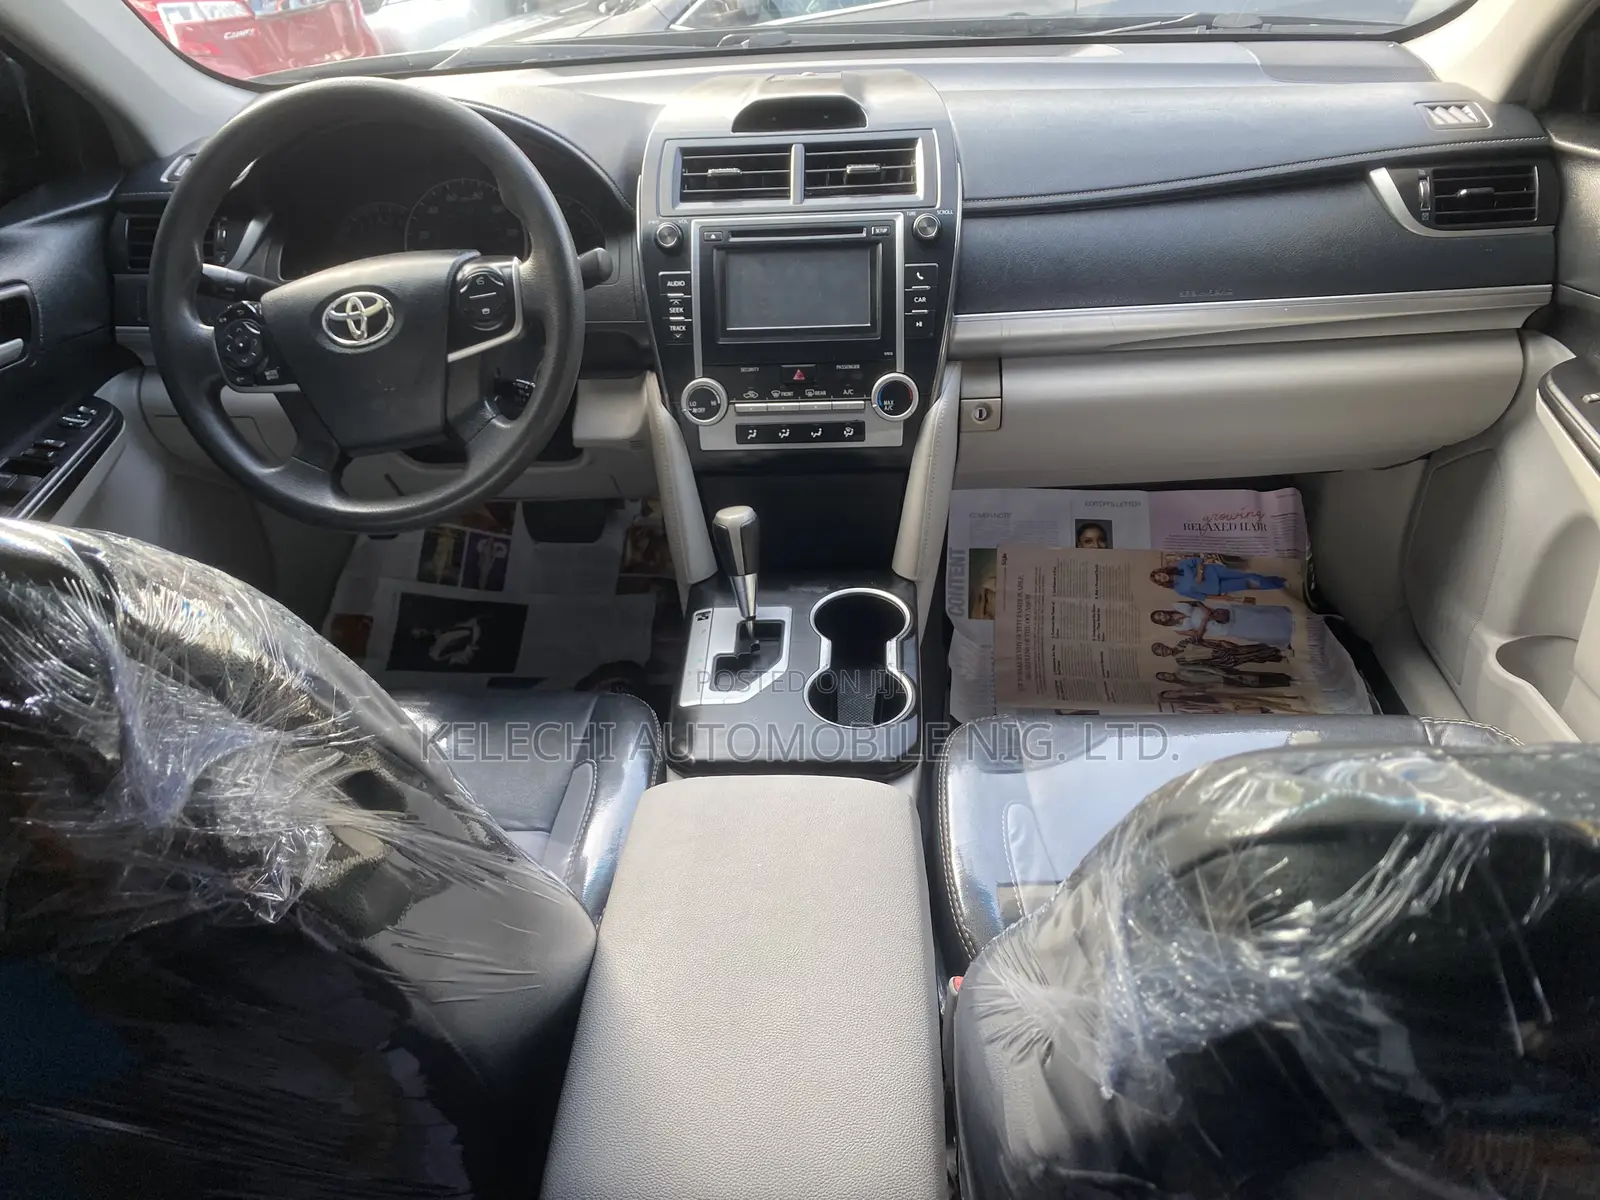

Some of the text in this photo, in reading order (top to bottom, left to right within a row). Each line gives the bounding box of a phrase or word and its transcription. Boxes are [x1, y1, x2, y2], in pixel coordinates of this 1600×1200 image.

[1183, 521, 1268, 532] RELAXED HAIR
[947, 546, 966, 618] CONTENT
